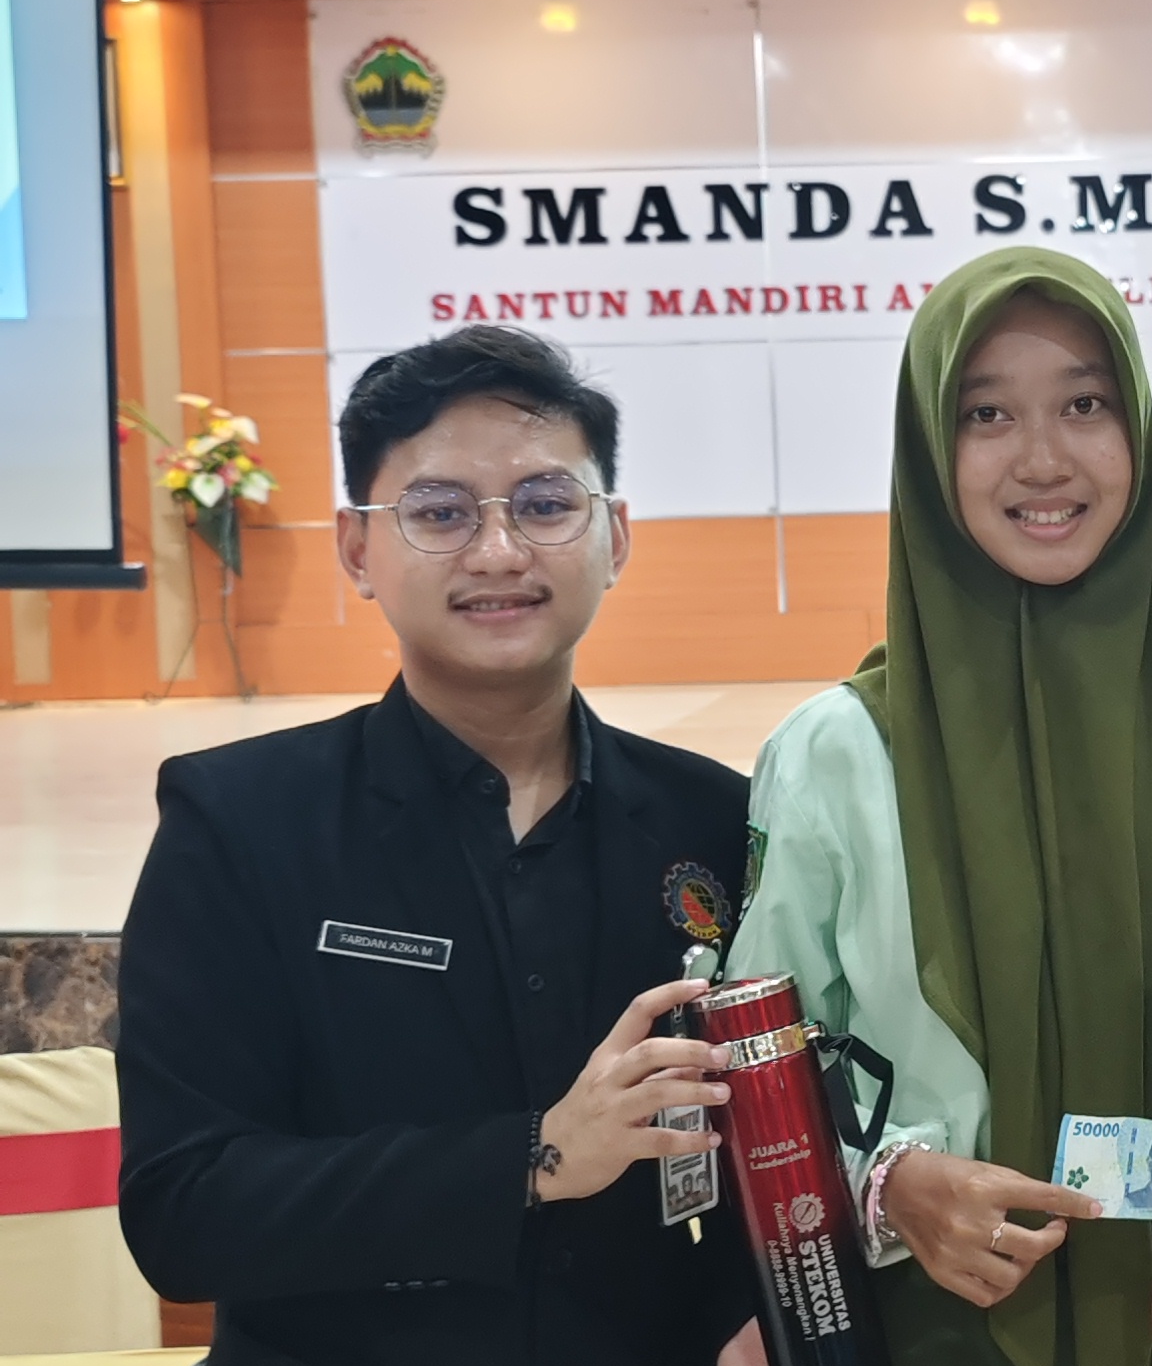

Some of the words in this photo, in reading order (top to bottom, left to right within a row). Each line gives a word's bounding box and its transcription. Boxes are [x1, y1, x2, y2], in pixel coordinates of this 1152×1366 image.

[453, 179, 933, 247] SMANDA
[431, 289, 629, 321] SANTUN
[648, 282, 868, 317] MANDIRI
[339, 933, 388, 950] FARDAN
[388, 941, 419, 955] AZKA
[421, 946, 434, 957] M
[748, 1138, 798, 1159] JUARA
[801, 1133, 809, 1144] 1
[1072, 1121, 1120, 1138] 50000
[750, 1149, 811, 1170] Leadership
[773, 1202, 793, 1254] Kuliahnya
[786, 1256, 813, 1335] Menyenangkan
[798, 1239, 837, 1337] STEKOM
[818, 1234, 851, 1331] UNIVERSITAS
